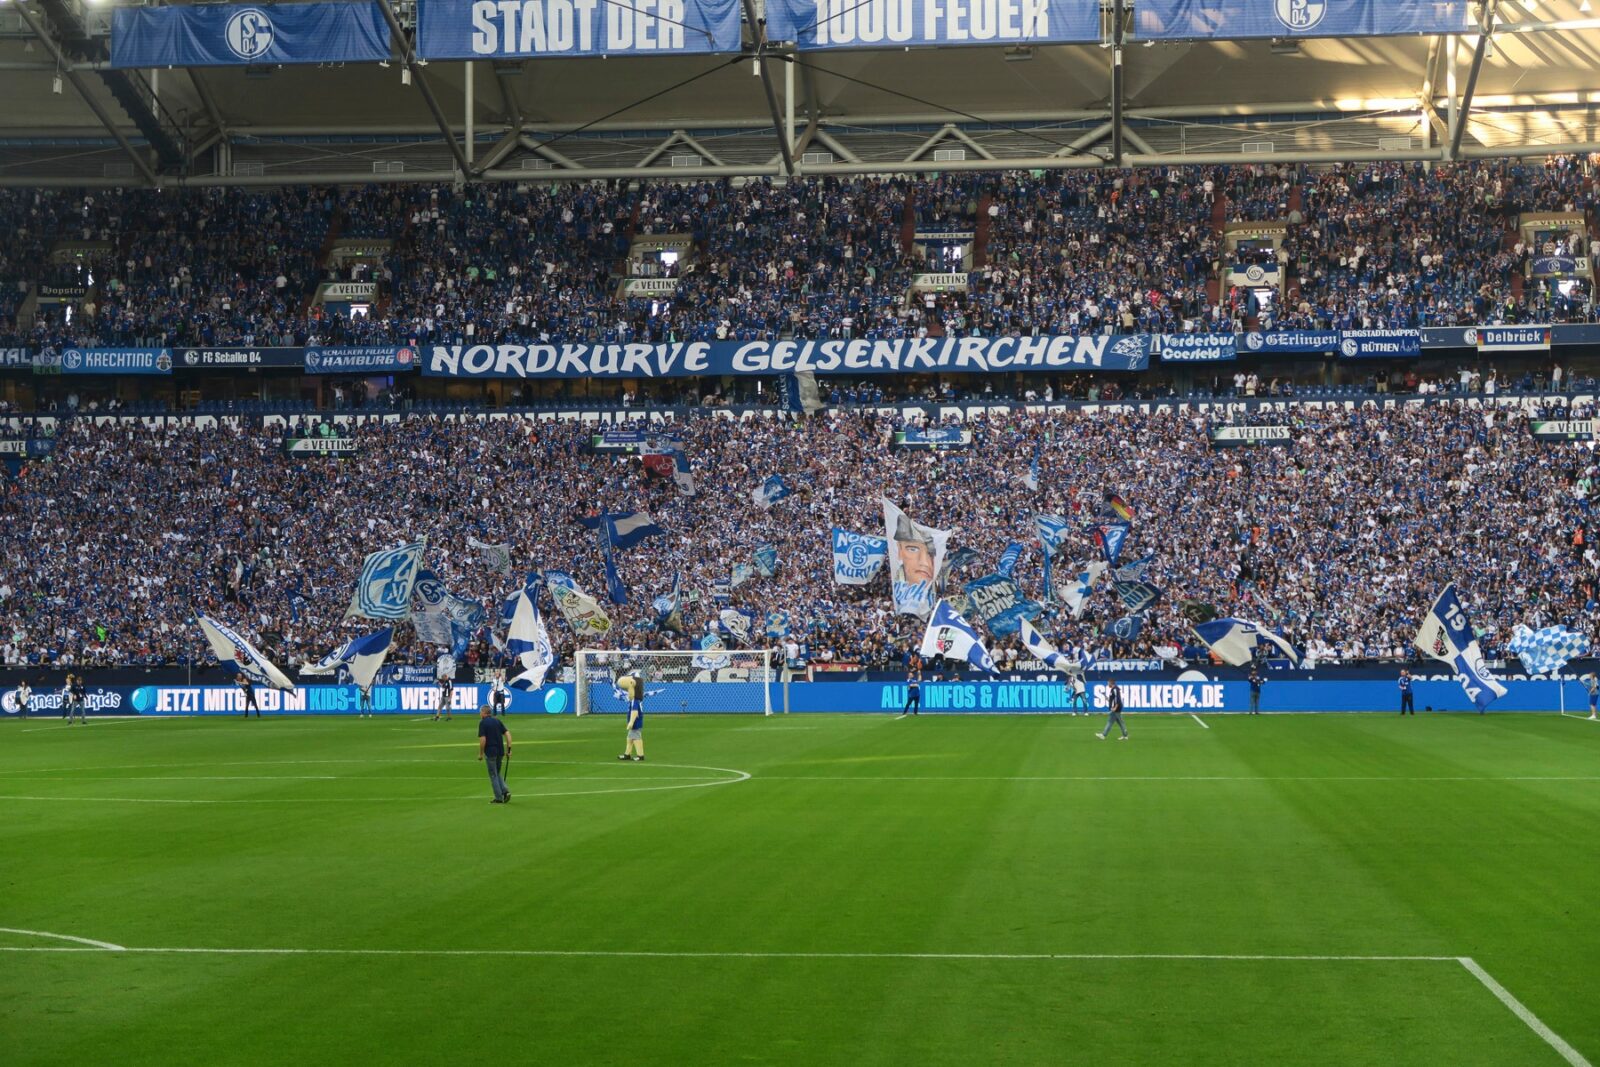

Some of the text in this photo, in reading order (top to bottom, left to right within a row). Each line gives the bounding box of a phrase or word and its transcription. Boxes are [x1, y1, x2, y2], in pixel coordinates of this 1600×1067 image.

[472, 0, 684, 54] STADT DER
[816, 0, 1049, 45] 1000 FEUER
[641, 280, 677, 290] VELTINS
[929, 275, 967, 285] VELTINS
[338, 285, 375, 294] VELTINS
[1342, 329, 1420, 338] BERGSTADTKNAPPEN
[1487, 331, 1541, 342] Delbrück
[1161, 347, 1221, 360] Coesfeld
[1361, 342, 1400, 353] RÜTHEN
[85, 352, 153, 367] KRECHTING
[202, 351, 261, 363] FC Schalke 04
[321, 355, 395, 367] HAMBURG
[430, 341, 711, 377] NORDKURVE
[732, 336, 1109, 371] GELSENKIRCHEN
[1238, 427, 1285, 438] VELTINS
[1445, 603, 1467, 631] 19
[155, 688, 200, 712] JETZT
[204, 687, 281, 711] MITGIED
[284, 687, 306, 710] IM
[400, 686, 478, 710] WEREN!
[925, 685, 976, 708] INFOS
[980, 685, 993, 708] &
